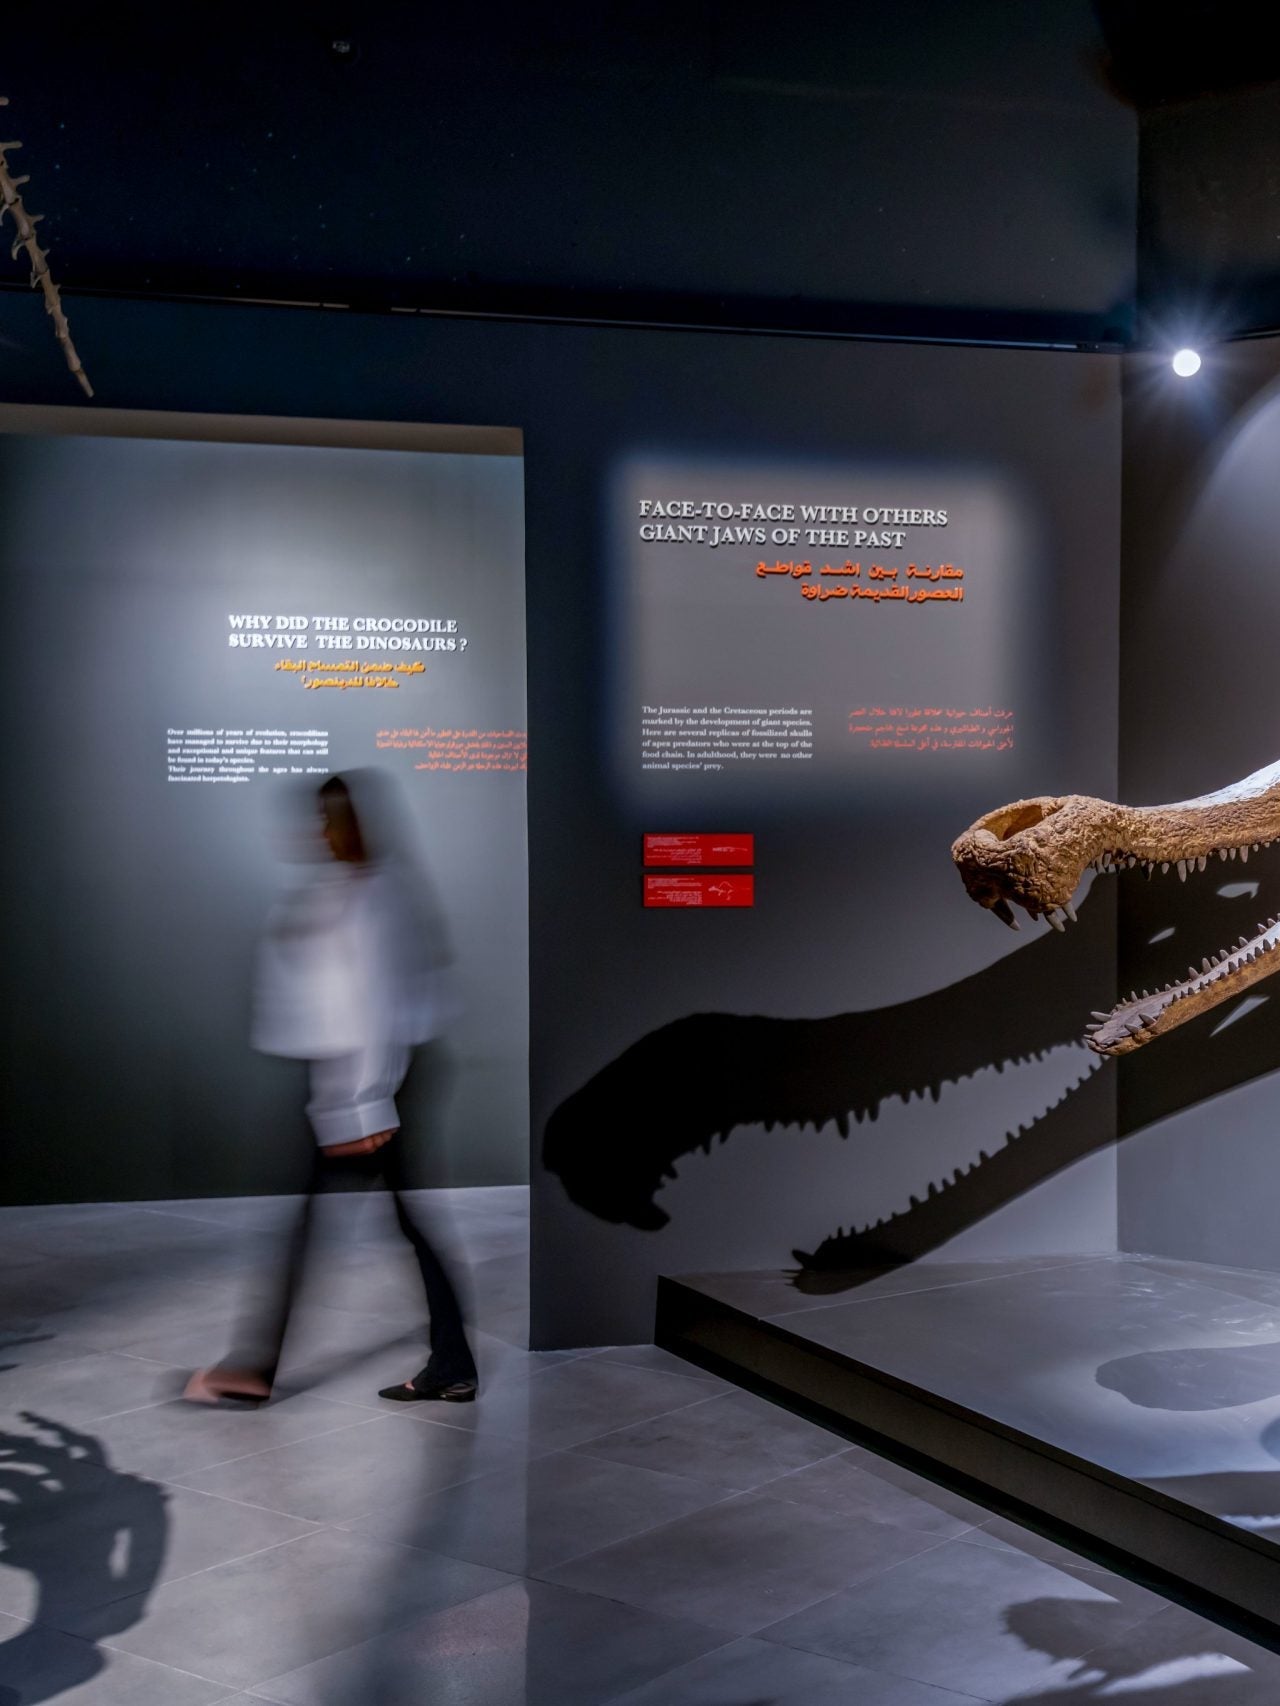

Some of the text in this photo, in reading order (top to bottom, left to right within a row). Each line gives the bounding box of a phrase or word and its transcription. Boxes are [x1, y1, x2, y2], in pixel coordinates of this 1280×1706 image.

[639, 500, 948, 526] FACE-TO-FACE WITH OTHERS
[639, 525, 906, 547] GIANT JAWS OF THE PAST
[757, 559, 812, 578] قواطع
[868, 563, 898, 580] بين
[907, 563, 964, 581] مقارنة
[228, 615, 458, 633] WHY DID THE CROCODILE
[228, 635, 308, 648] SURVIVE
[316, 636, 353, 649] THE
[357, 636, 456, 651] DINOSAURS
[659, 706, 690, 715] Jurassic
[769, 708, 798, 716] periods
[675, 718, 684, 727] by
[700, 718, 750, 727] development
[761, 719, 780, 727] giant
[709, 730, 739, 738] replicas
[673, 741, 711, 749] predators
[741, 752, 756, 760] they
